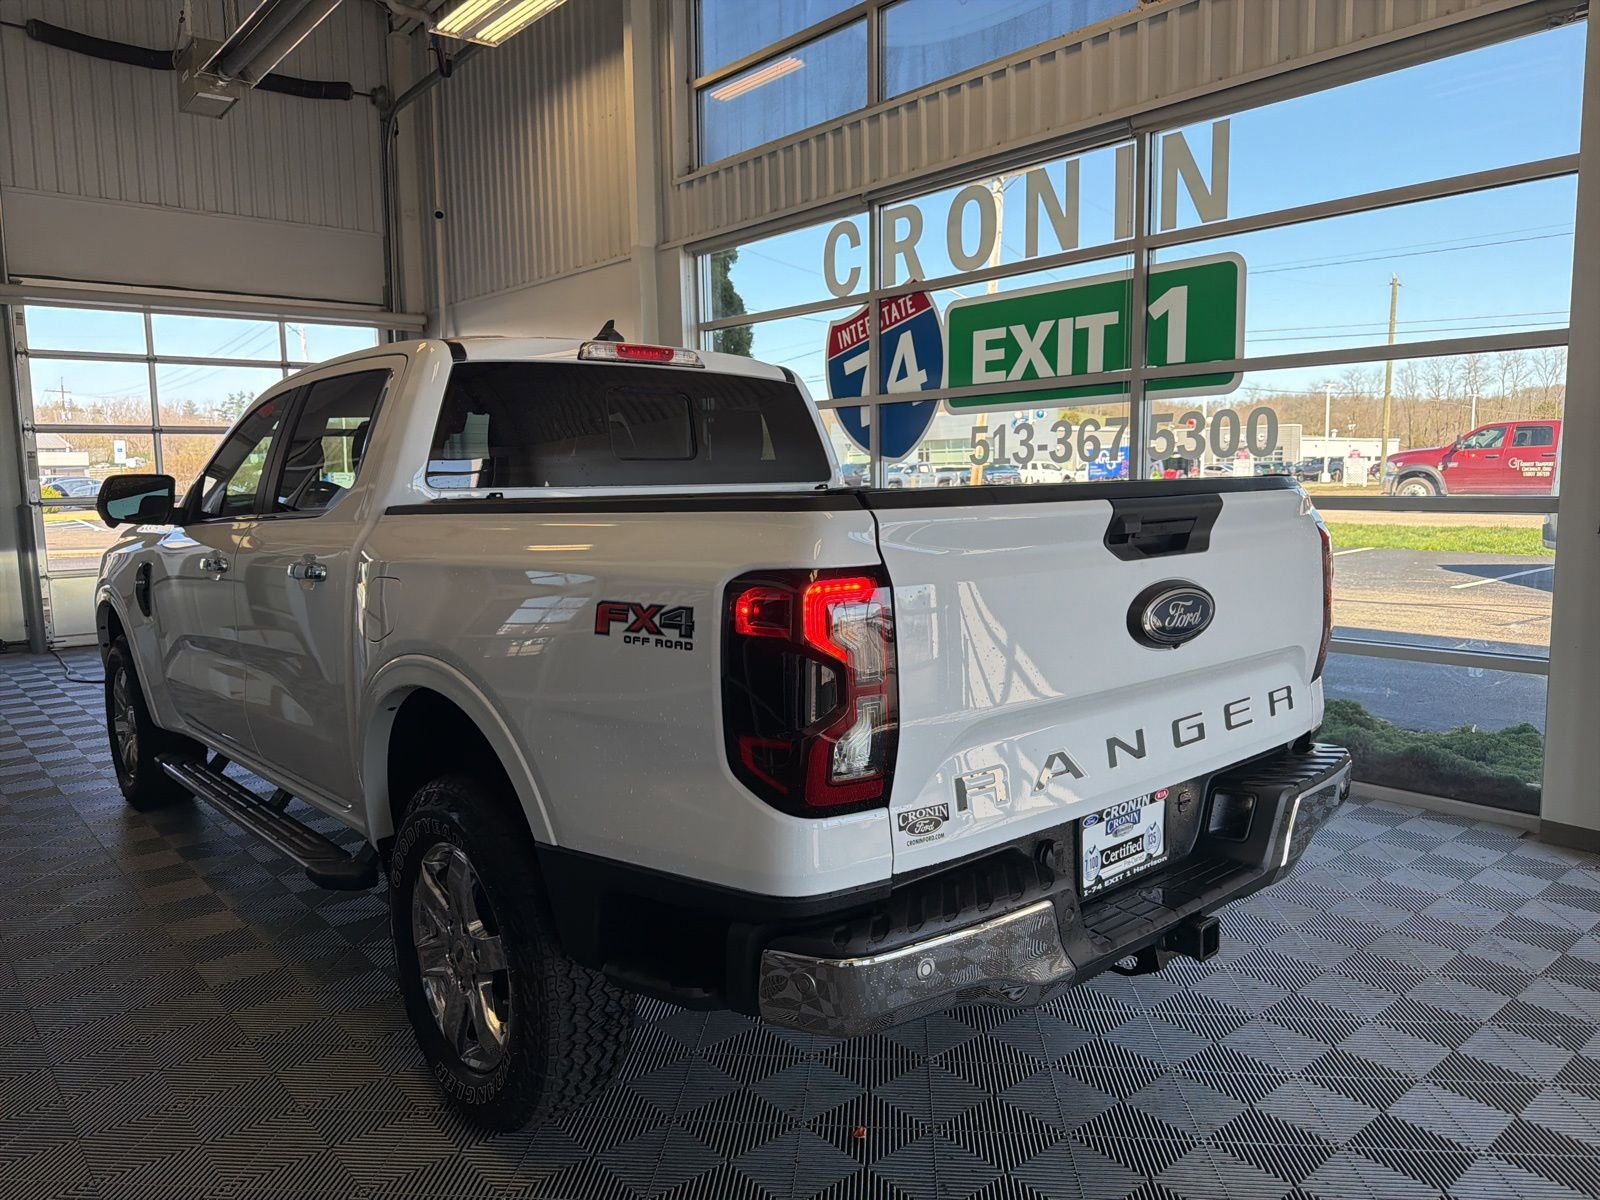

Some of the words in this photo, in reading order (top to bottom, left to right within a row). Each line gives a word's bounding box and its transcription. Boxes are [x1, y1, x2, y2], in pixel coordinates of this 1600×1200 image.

[823, 118, 1231, 298] CRONIN
[837, 294, 916, 350] INTERTATE
[972, 310, 1119, 385] EXIT
[1148, 284, 1188, 364] 1
[843, 329, 928, 428] 74
[594, 600, 695, 639] FX4
[1165, 600, 1202, 628] Ford
[623, 635, 650, 646] OFF
[655, 638, 693, 651] ROAD
[954, 685, 1295, 817] RANGER
[899, 804, 948, 827] CRONIN
[1102, 793, 1150, 821] CRONIN
[1107, 810, 1140, 834] CRONIN
[914, 819, 935, 834] Ford
[1102, 837, 1143, 865] Certified
[1084, 884, 1103, 897] I-74
[1104, 873, 1124, 886] EXIT
[1133, 856, 1168, 873] Harrison
